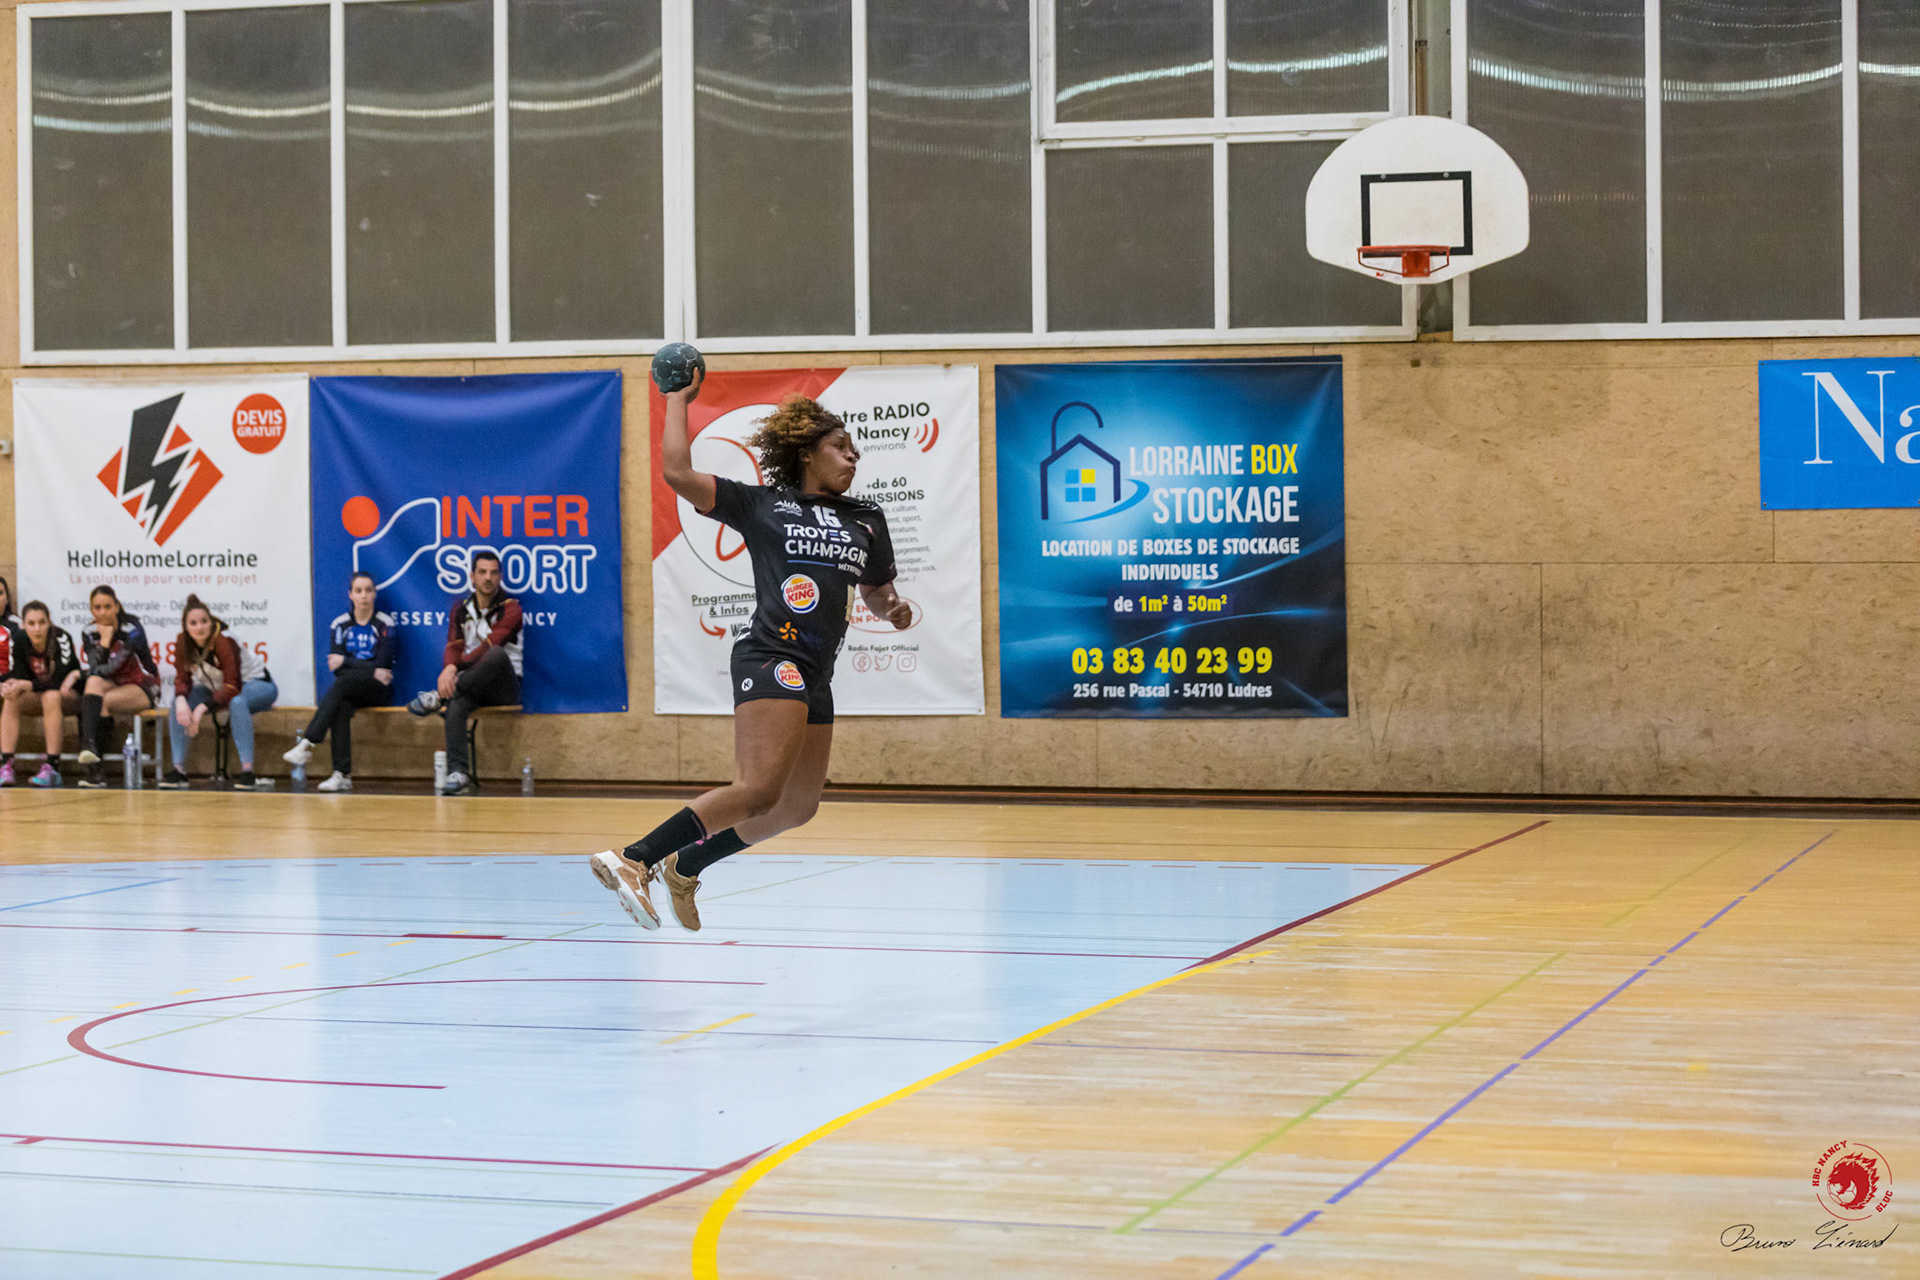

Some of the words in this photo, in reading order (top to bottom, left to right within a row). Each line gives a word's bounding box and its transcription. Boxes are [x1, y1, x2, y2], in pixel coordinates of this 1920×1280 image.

[236, 409, 283, 425] DEVIS
[841, 410, 868, 424] tre
[873, 402, 930, 421] RADIO
[236, 426, 283, 437] GRATUIT
[857, 426, 910, 441] Nancy
[863, 442, 907, 453] environs
[1129, 445, 1244, 477] LORRAINE
[1251, 444, 1298, 475] BOX
[891, 476, 907, 488] 60
[1152, 485, 1300, 525] STOCKAGE
[441, 495, 590, 538] INTER
[811, 504, 843, 528] 15
[783, 523, 852, 544] TROYES
[1041, 539, 1112, 557] LOCATION
[1117, 539, 1138, 556] DE
[1142, 538, 1193, 556] BOXES
[1197, 538, 1218, 555] DE
[1222, 537, 1300, 555] STOCKAGE
[67, 548, 258, 569] HelloHomeLorraine
[69, 574, 82, 584] La
[87, 573, 139, 584] solution
[143, 575, 173, 586] pour
[178, 574, 211, 584] votre
[217, 573, 257, 587] projet
[1121, 563, 1219, 581] INDIVIDUELS
[786, 582, 813, 595] BURGER
[787, 588, 815, 604] KING
[241, 599, 267, 610] Neuf
[709, 606, 717, 616] &
[721, 604, 749, 616] Infos
[1113, 596, 1133, 612] de
[1138, 594, 1168, 612] 1m²
[1173, 596, 1183, 612] à
[1187, 594, 1227, 612] 50m²
[851, 615, 863, 624] EN
[1071, 647, 1104, 674] 03
[1112, 647, 1145, 674] 83
[1154, 647, 1187, 674] 40
[1196, 647, 1228, 674] 23
[1237, 647, 1273, 674] 99
[1073, 683, 1099, 698] 256
[1103, 686, 1126, 698] rue
[1129, 683, 1170, 698] Pascal
[1182, 683, 1223, 698] 54710
[1227, 683, 1273, 698] Ludres
